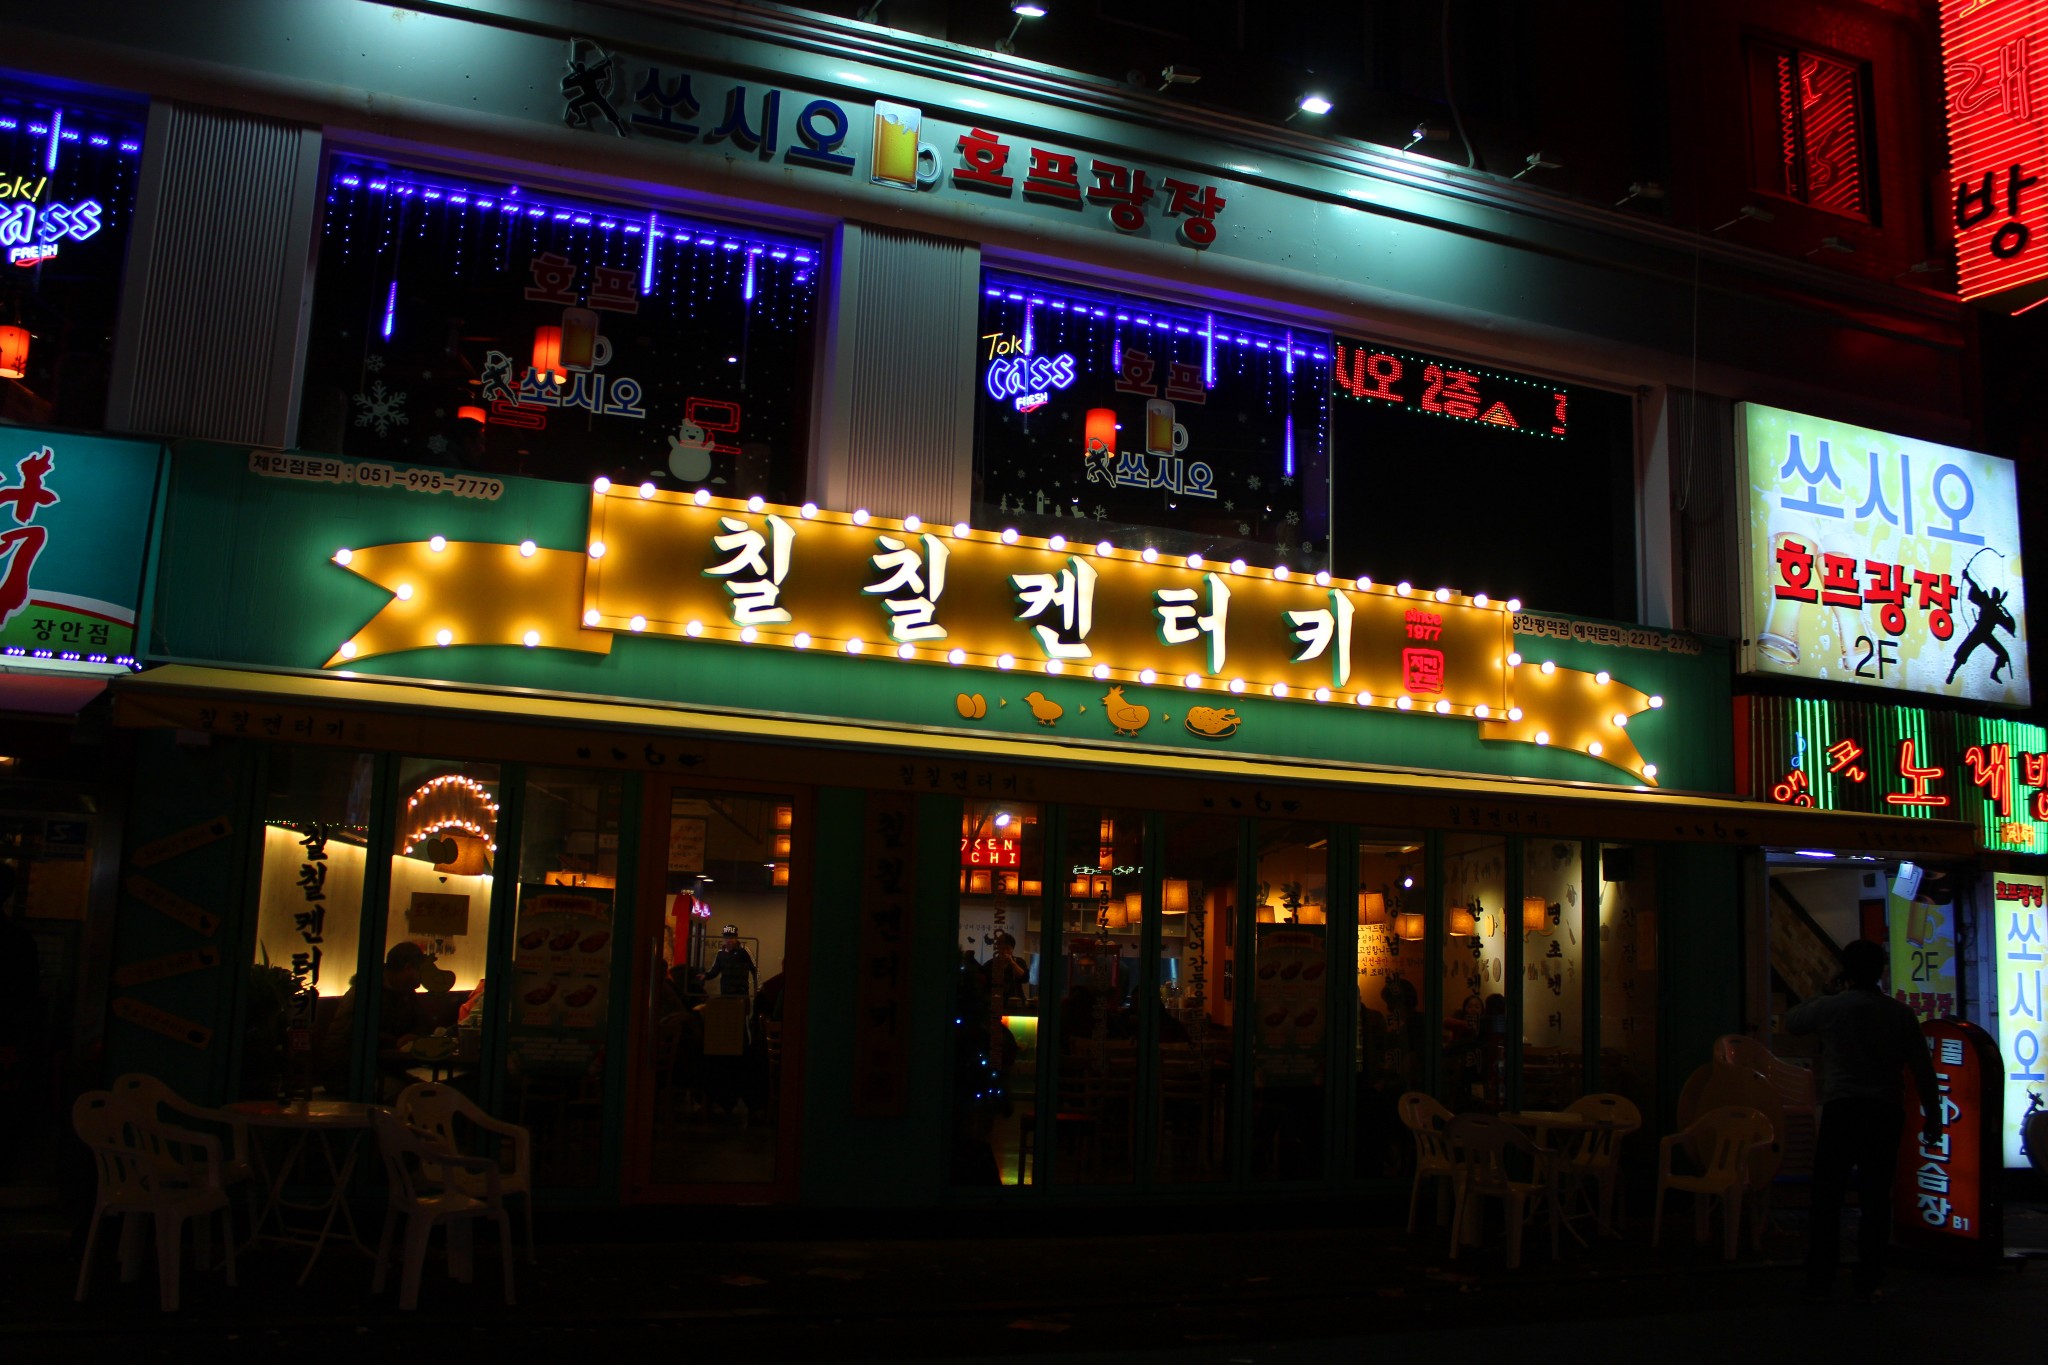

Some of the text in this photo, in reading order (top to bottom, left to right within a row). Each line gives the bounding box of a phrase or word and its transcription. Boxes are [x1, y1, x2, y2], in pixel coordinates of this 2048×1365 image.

[628, 67, 855, 172] 쏘시오
[0, 171, 47, 203] ok!
[952, 127, 1226, 245] 호프광장
[524, 251, 640, 315] 호프
[518, 366, 646, 419] 쏘시오
[1114, 347, 1207, 405] 호프
[253, 454, 340, 479] 체인점문의
[359, 465, 501, 497] 051-995-7779
[1116, 451, 1218, 500] 쏘시오
[1780, 434, 1986, 546] 쏘시오
[701, 513, 1357, 688] 칠칠켄터키
[1774, 538, 1958, 642] 호프광장
[32, 618, 110, 646] 장안점
[1404, 608, 1442, 625] since
[1405, 624, 1443, 641] 1977
[1630, 631, 1700, 651] 2212-2790
[1854, 635, 1899, 680] 2F
[199, 707, 345, 741] 칠칠켄터키
[1996, 880, 2045, 908] 호프광장
[290, 822, 329, 1025] 칠칠켄터키
[1911, 950, 1939, 982] 2F
[2007, 912, 2046, 1082] 쏘시오
[1953, 1215, 1970, 1232] B1
